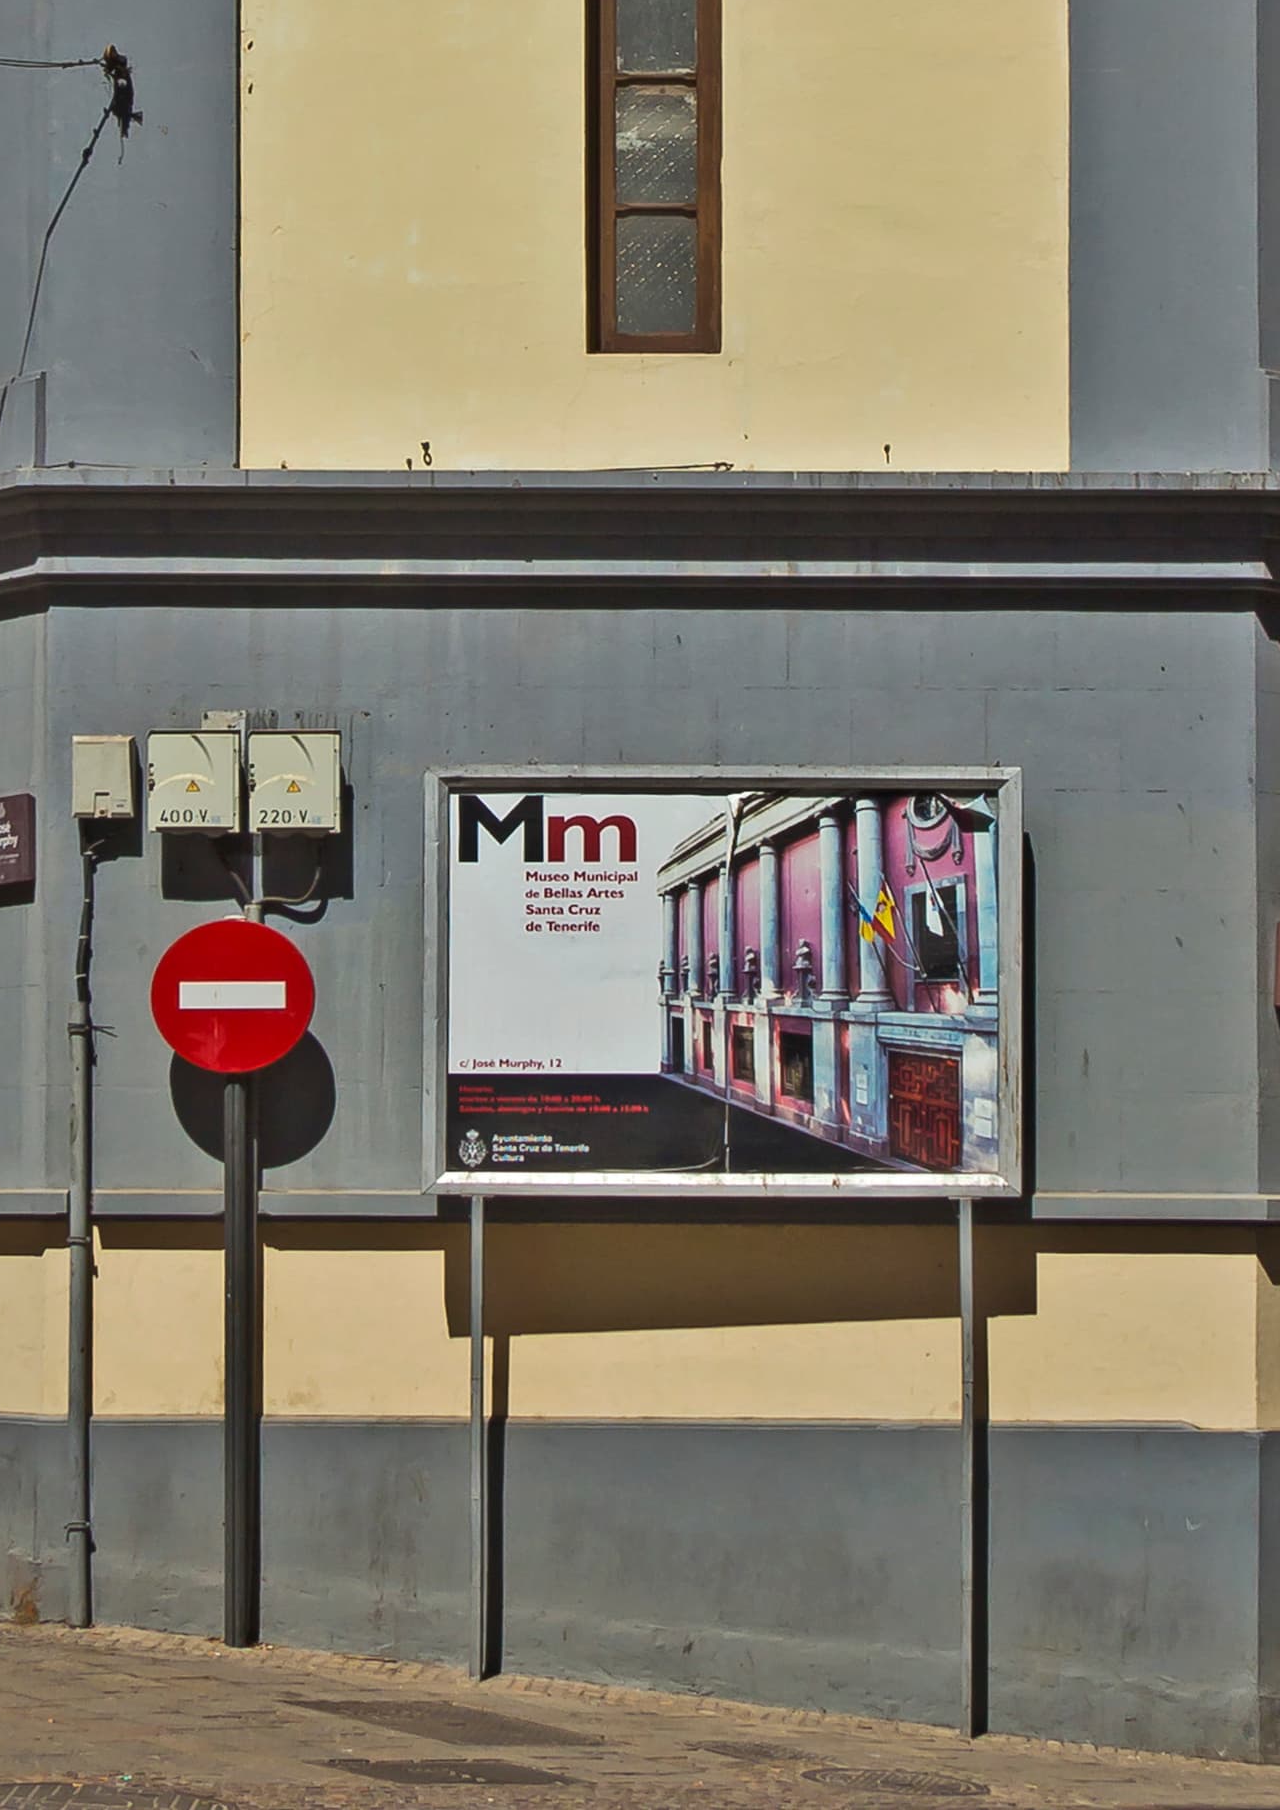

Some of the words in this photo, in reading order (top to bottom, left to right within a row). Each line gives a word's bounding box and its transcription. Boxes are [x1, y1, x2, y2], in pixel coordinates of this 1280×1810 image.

[160, 809, 193, 823] 400
[259, 810, 292, 824] 220
[459, 795, 637, 862] Mm
[525, 871, 570, 882] Museo
[573, 871, 638, 884] Municipal
[525, 889, 540, 898] de
[543, 888, 583, 898] Bellas
[586, 888, 625, 898] Artes
[525, 904, 564, 915] Santa
[568, 904, 601, 915] Cruz
[525, 921, 542, 931] de
[546, 921, 600, 932] Tenerife
[472, 1059, 495, 1070] José
[499, 1059, 545, 1070] Murphy,
[550, 1059, 562, 1068] 12
[492, 1144, 517, 1152] Santa
[519, 1143, 539, 1152] Cruz
[541, 1144, 552, 1152] de
[554, 1143, 590, 1153] Tenerife
[492, 1153, 524, 1162] Cultura
